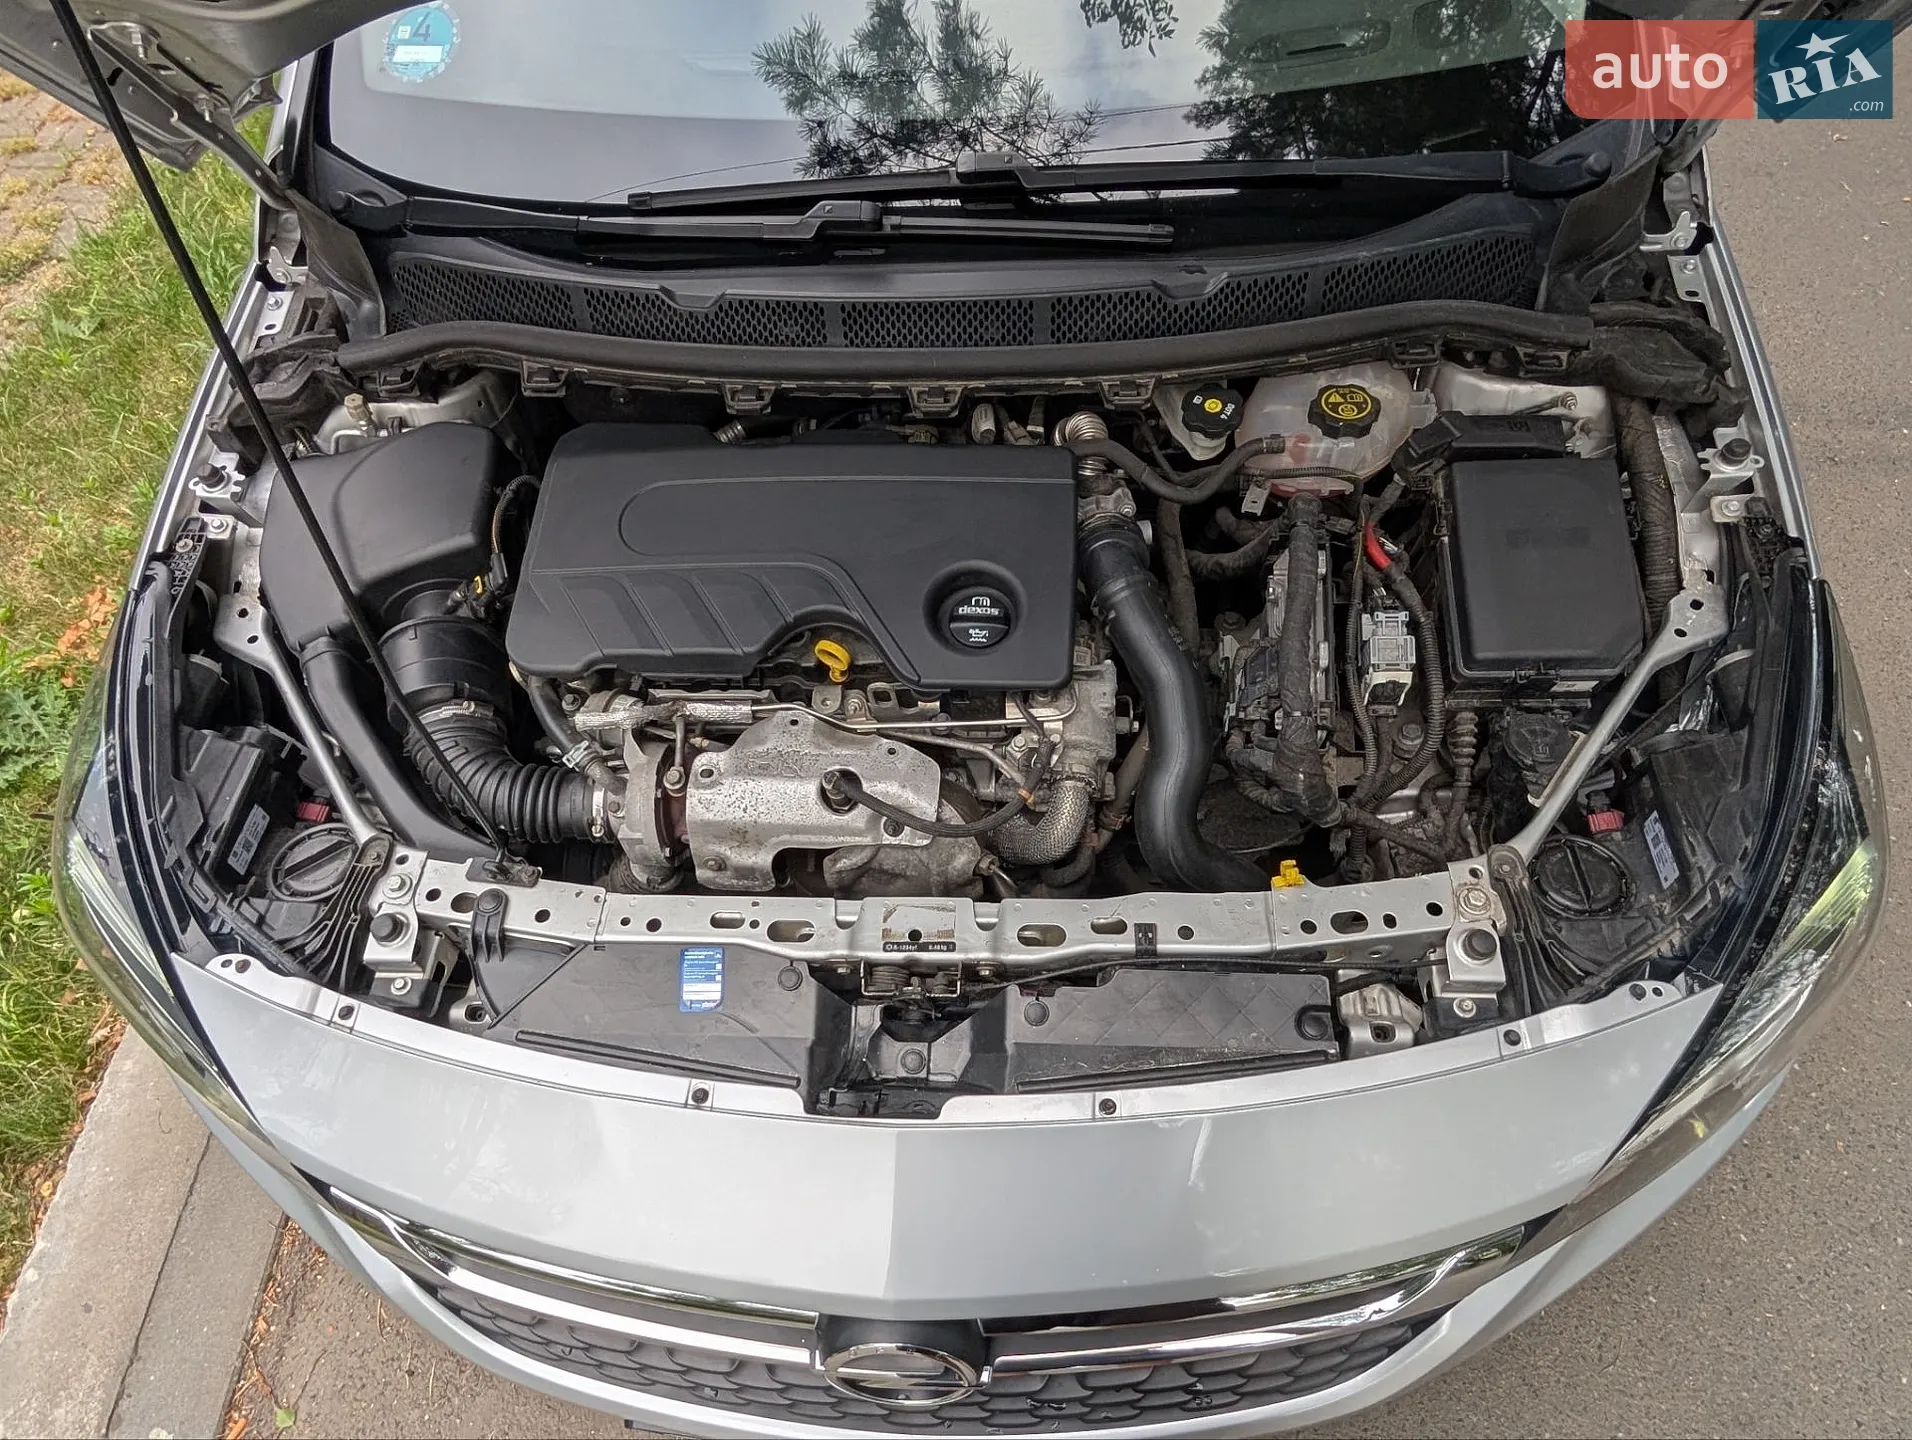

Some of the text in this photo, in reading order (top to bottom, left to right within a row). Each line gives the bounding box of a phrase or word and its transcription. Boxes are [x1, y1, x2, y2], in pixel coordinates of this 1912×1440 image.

[412, 11, 431, 42] 4
[1223, 402, 1236, 416] DOT
[958, 605, 1000, 616] dexos
